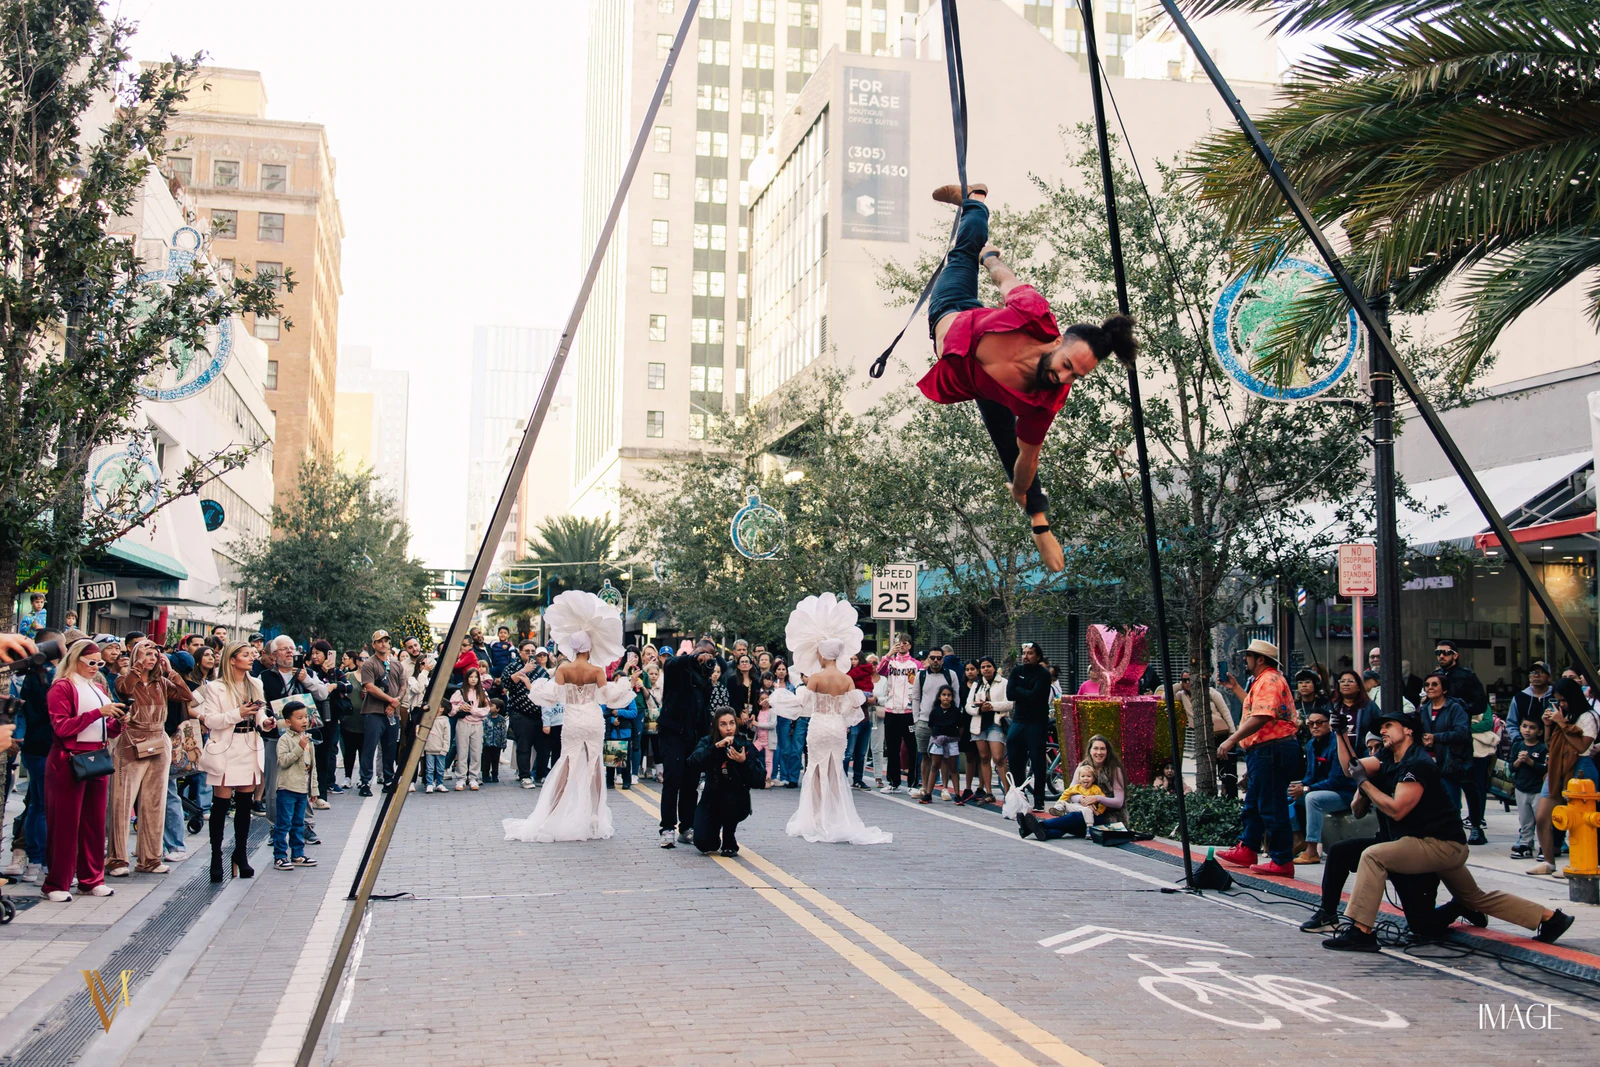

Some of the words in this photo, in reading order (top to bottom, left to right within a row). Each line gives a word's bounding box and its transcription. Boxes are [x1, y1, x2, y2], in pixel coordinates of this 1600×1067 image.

[849, 79, 883, 93] FOR
[849, 93, 900, 109] LEASE
[848, 108, 884, 117] BOUTIQUE
[848, 116, 874, 125] OFFICE
[875, 118, 899, 127] SUITES
[848, 146, 886, 161] (305)
[848, 162, 908, 177] 576.1430
[1351, 547, 1362, 556] NO
[1343, 556, 1372, 564] STOPPING
[1352, 563, 1362, 571] OR
[876, 568, 913, 579] SPEED
[1343, 570, 1372, 578] STANDING
[880, 581, 909, 590] LIMIT
[86, 583, 112, 600] SHOP
[878, 592, 911, 613] 25
